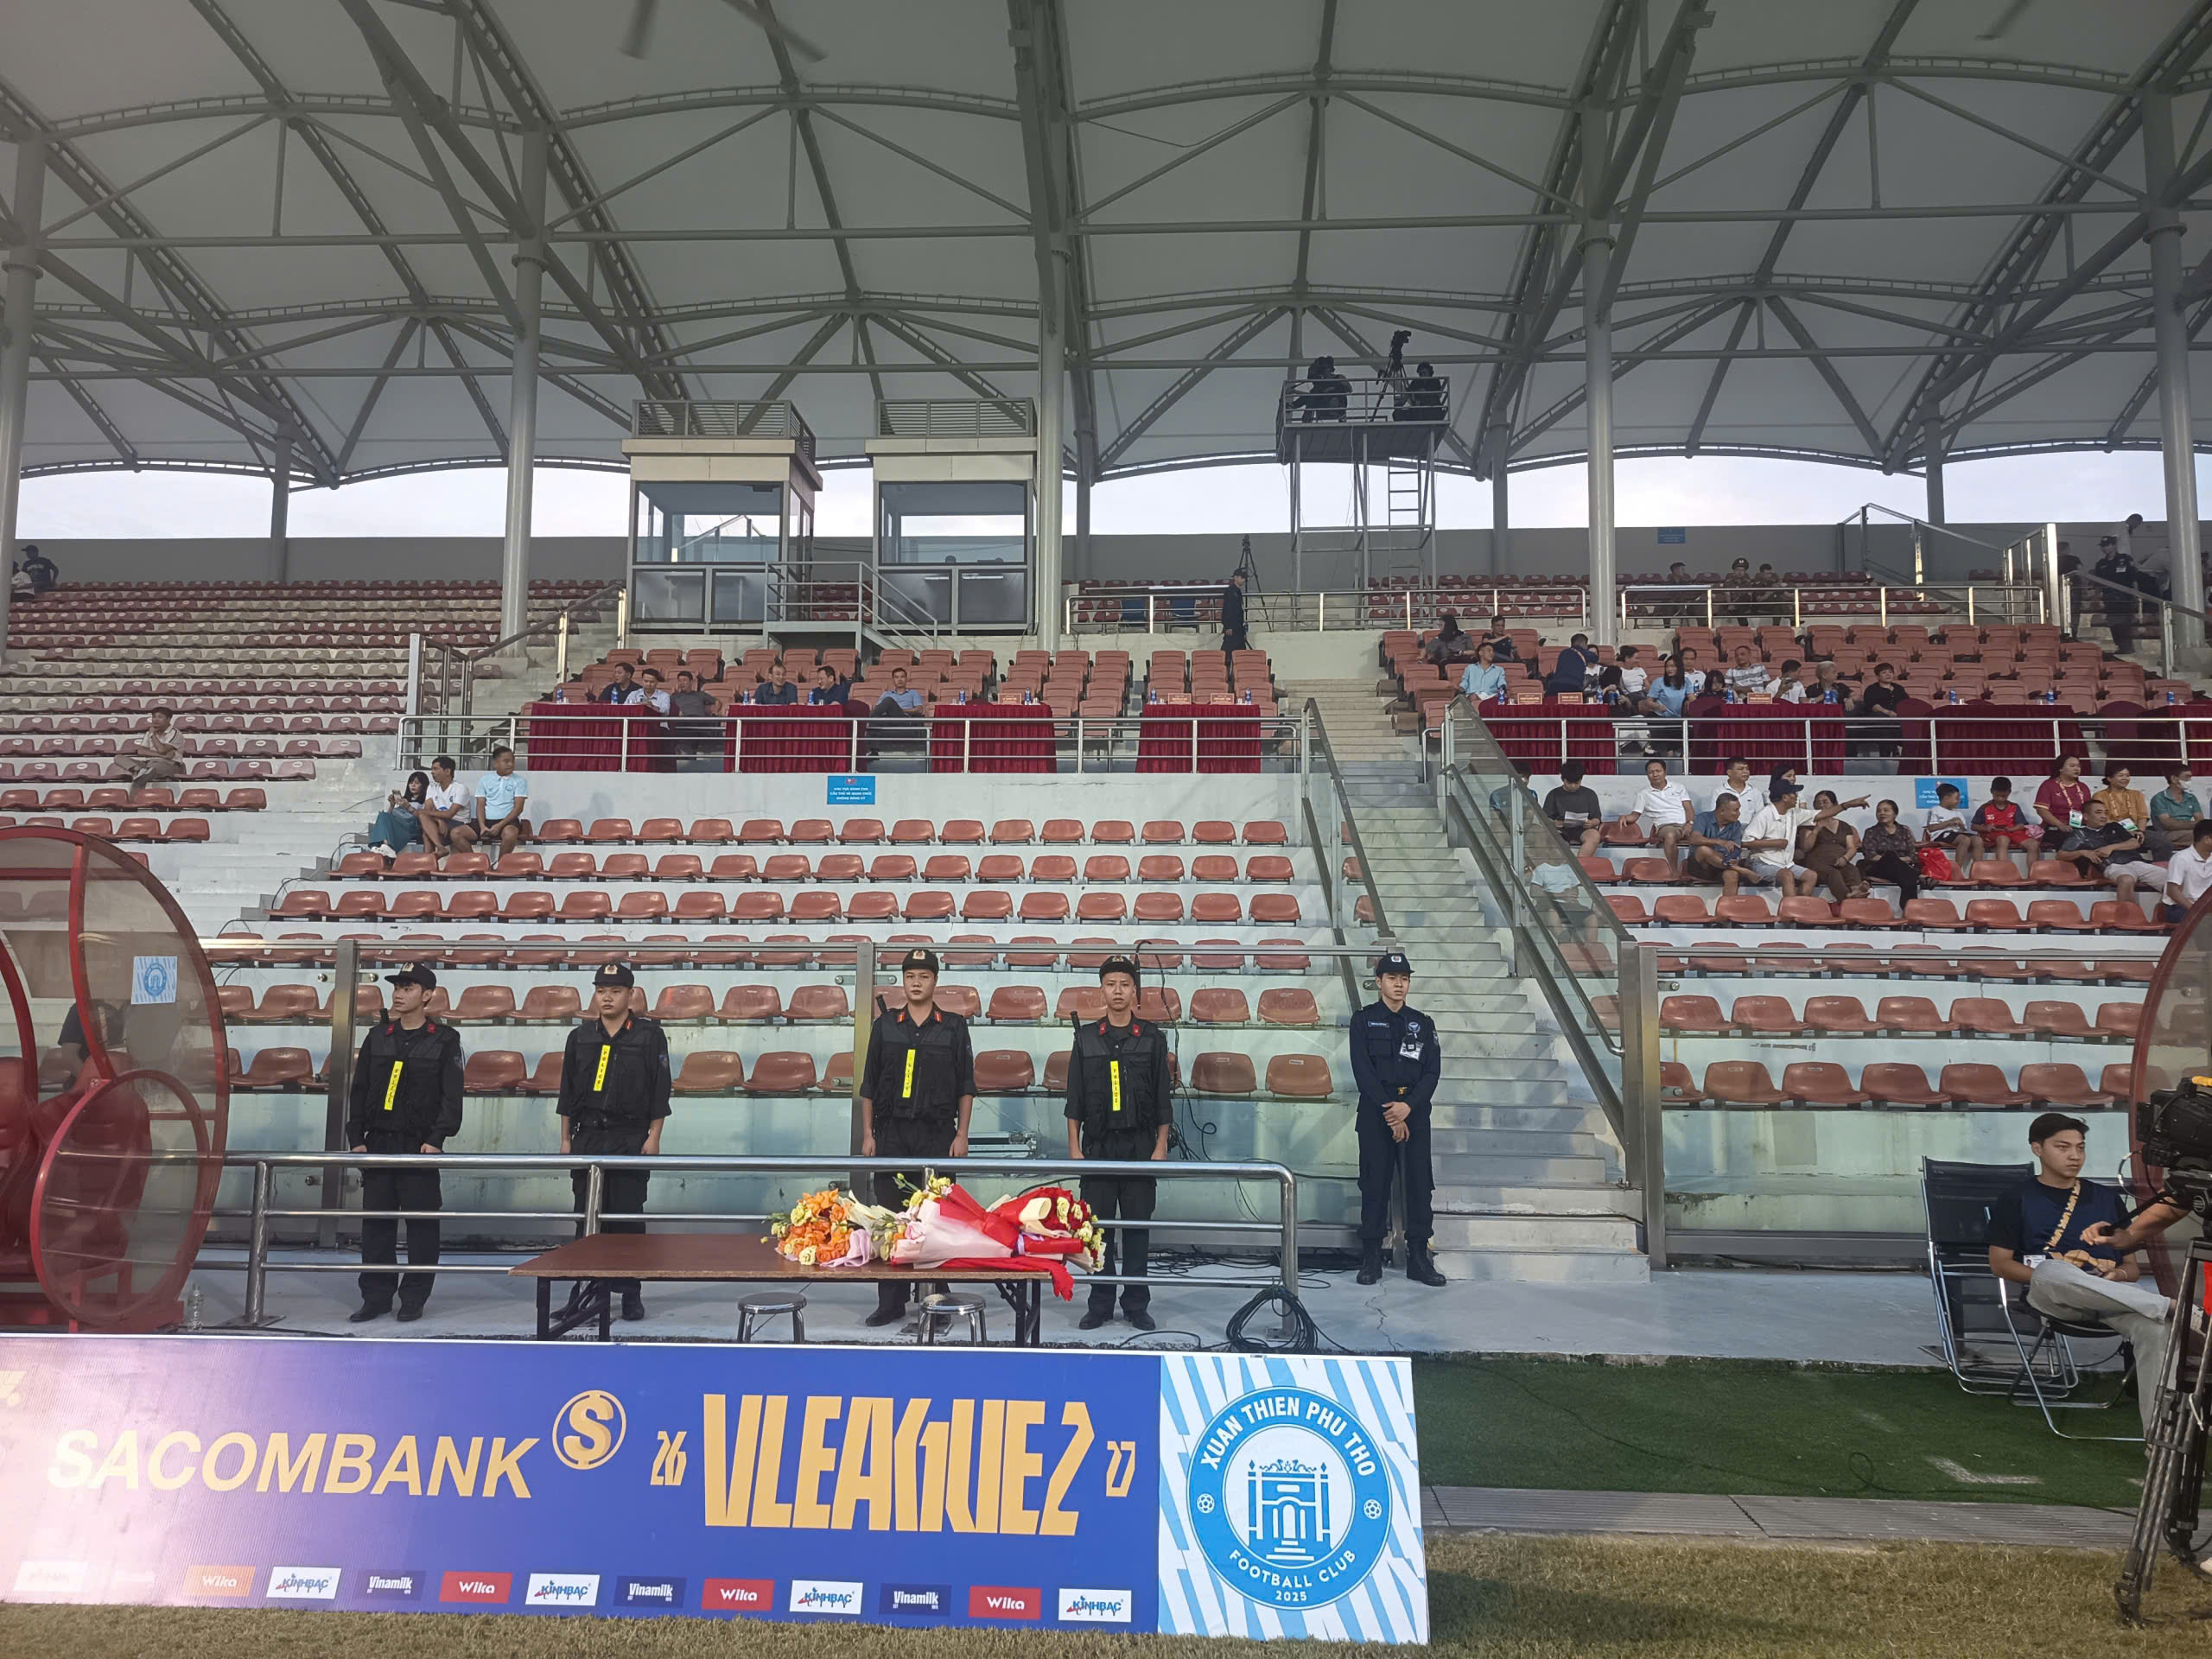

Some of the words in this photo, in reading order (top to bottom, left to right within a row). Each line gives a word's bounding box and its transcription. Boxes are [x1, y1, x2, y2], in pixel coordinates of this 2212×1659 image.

[596, 1050, 608, 1085] POLICE
[1199, 1415, 1245, 1472] XUAN
[1241, 1395, 1300, 1426] THIEN
[1306, 1401, 1348, 1438] PHU
[1343, 1431, 1377, 1478] THO
[47, 1429, 540, 1499] SACOMBANK
[649, 1431, 688, 1487] 26
[1104, 1440, 1136, 1498] 27
[1228, 1548, 1313, 1589] FOOTBALL
[1319, 1548, 1357, 1583] CLUB
[201, 1574, 238, 1588] Wika
[368, 1575, 414, 1590] Vinamilk
[458, 1580, 496, 1595] Wika
[628, 1582, 674, 1598] Vinamilk
[720, 1587, 759, 1602] Wika
[893, 1590, 939, 1605] Vinamilk
[1274, 1590, 1308, 1602] 2025
[986, 1595, 1026, 1611] Wika
